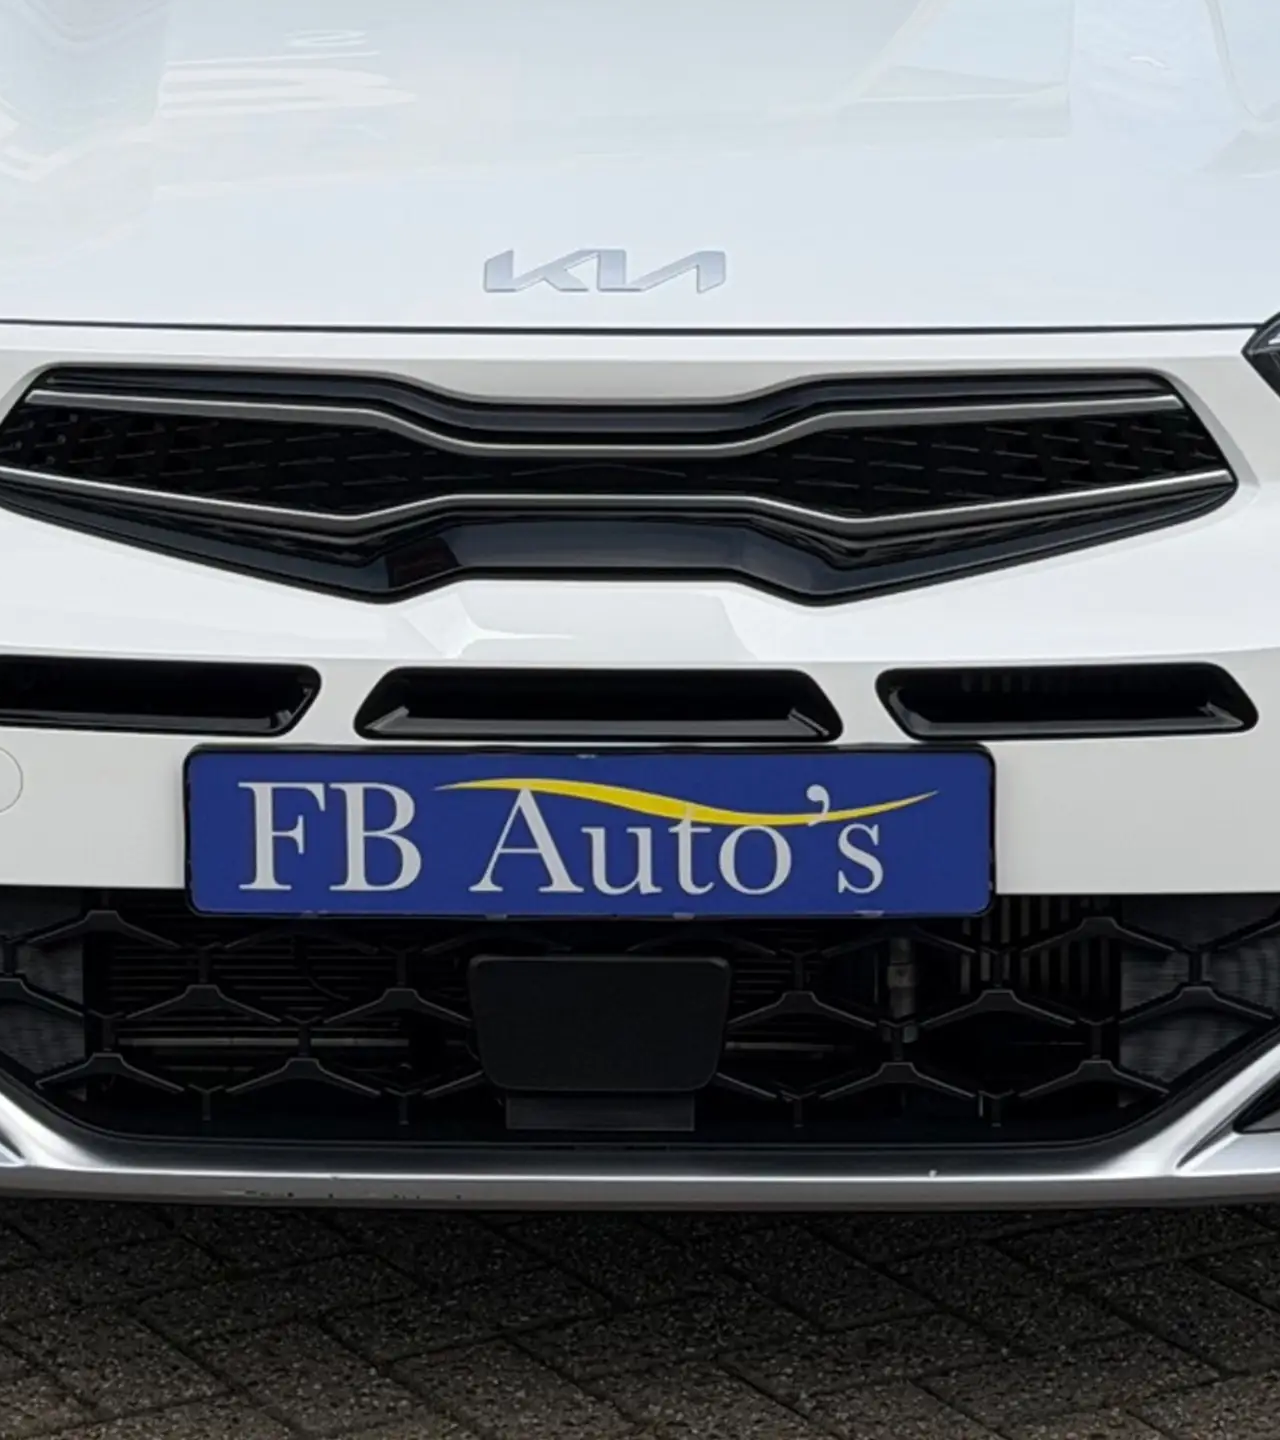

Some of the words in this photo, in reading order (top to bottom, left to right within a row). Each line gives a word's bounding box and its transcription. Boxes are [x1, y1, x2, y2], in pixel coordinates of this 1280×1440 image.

[483, 248, 727, 295] KIA
[237, 781, 421, 892] FB
[469, 782, 885, 895] Auto's
